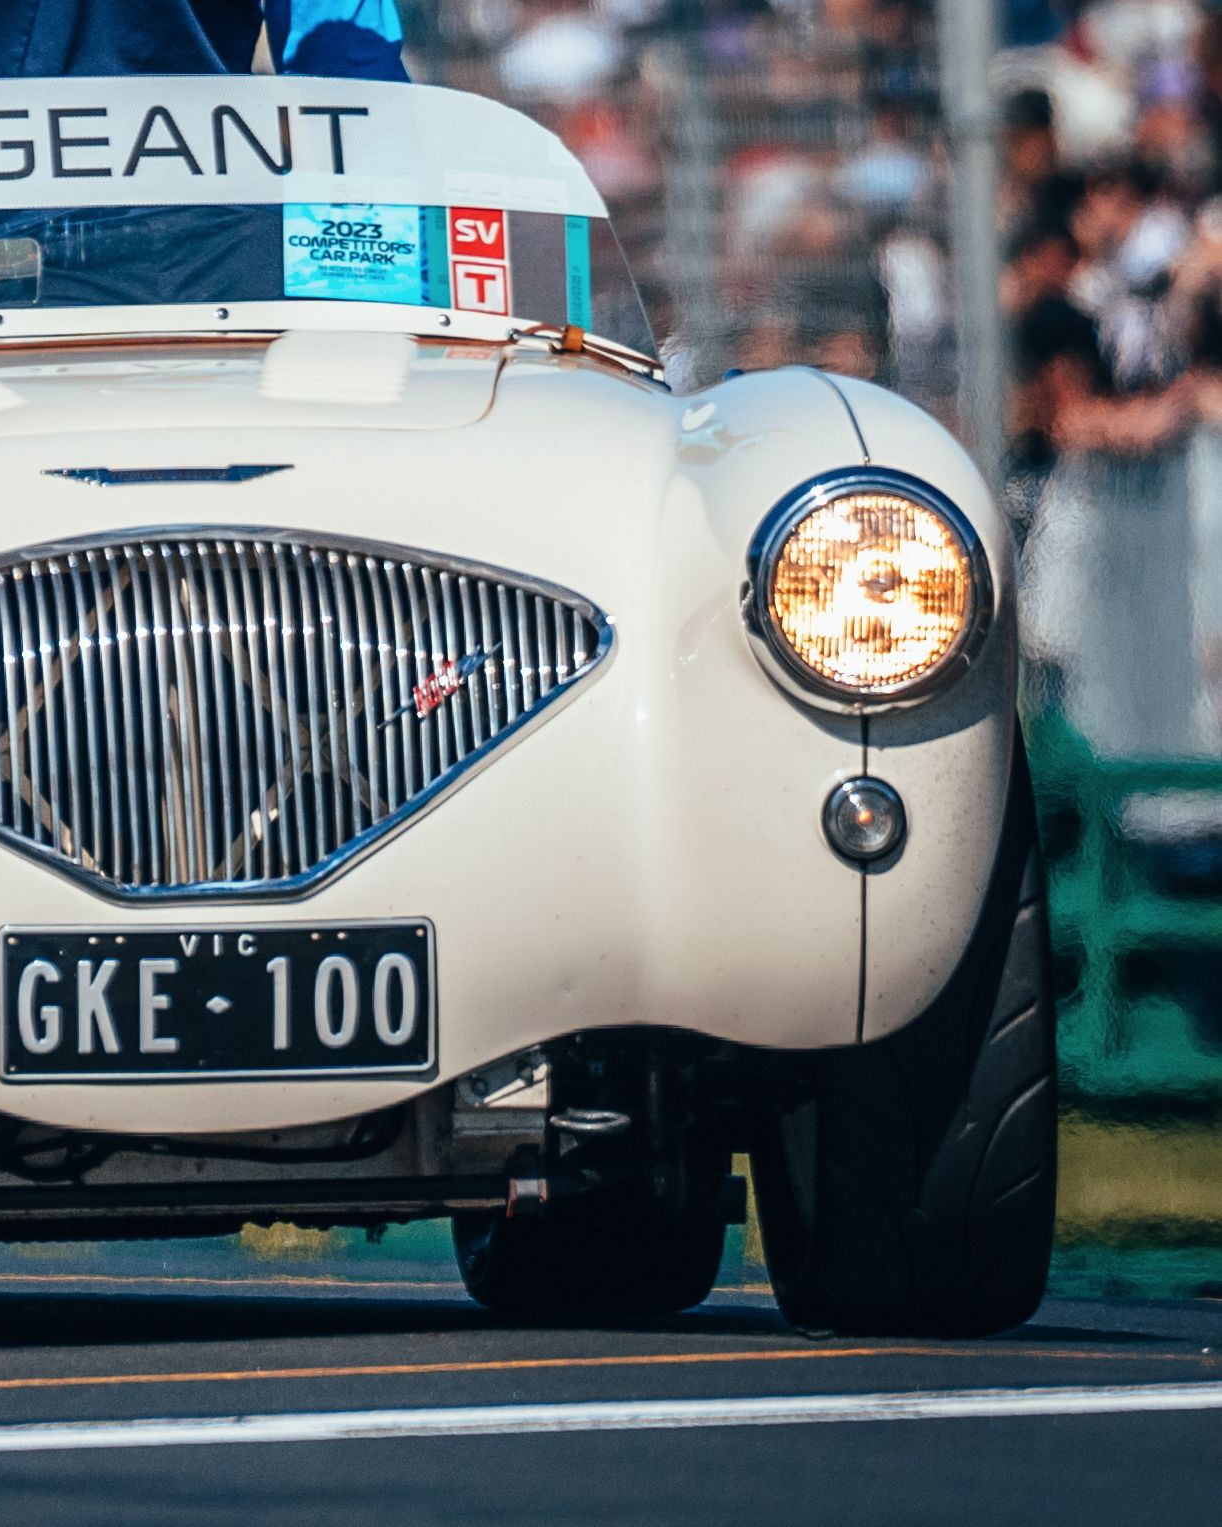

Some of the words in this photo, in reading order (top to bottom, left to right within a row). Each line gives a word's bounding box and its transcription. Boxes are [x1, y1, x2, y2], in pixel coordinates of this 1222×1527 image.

[321, 220, 383, 239] 2023
[454, 218, 500, 245] SV
[309, 248, 346, 262] CAR
[348, 251, 396, 266] PARK
[463, 271, 497, 304] T
[179, 933, 257, 957] VIC
[17, 958, 180, 1054] GKE
[265, 953, 419, 1051] 100
